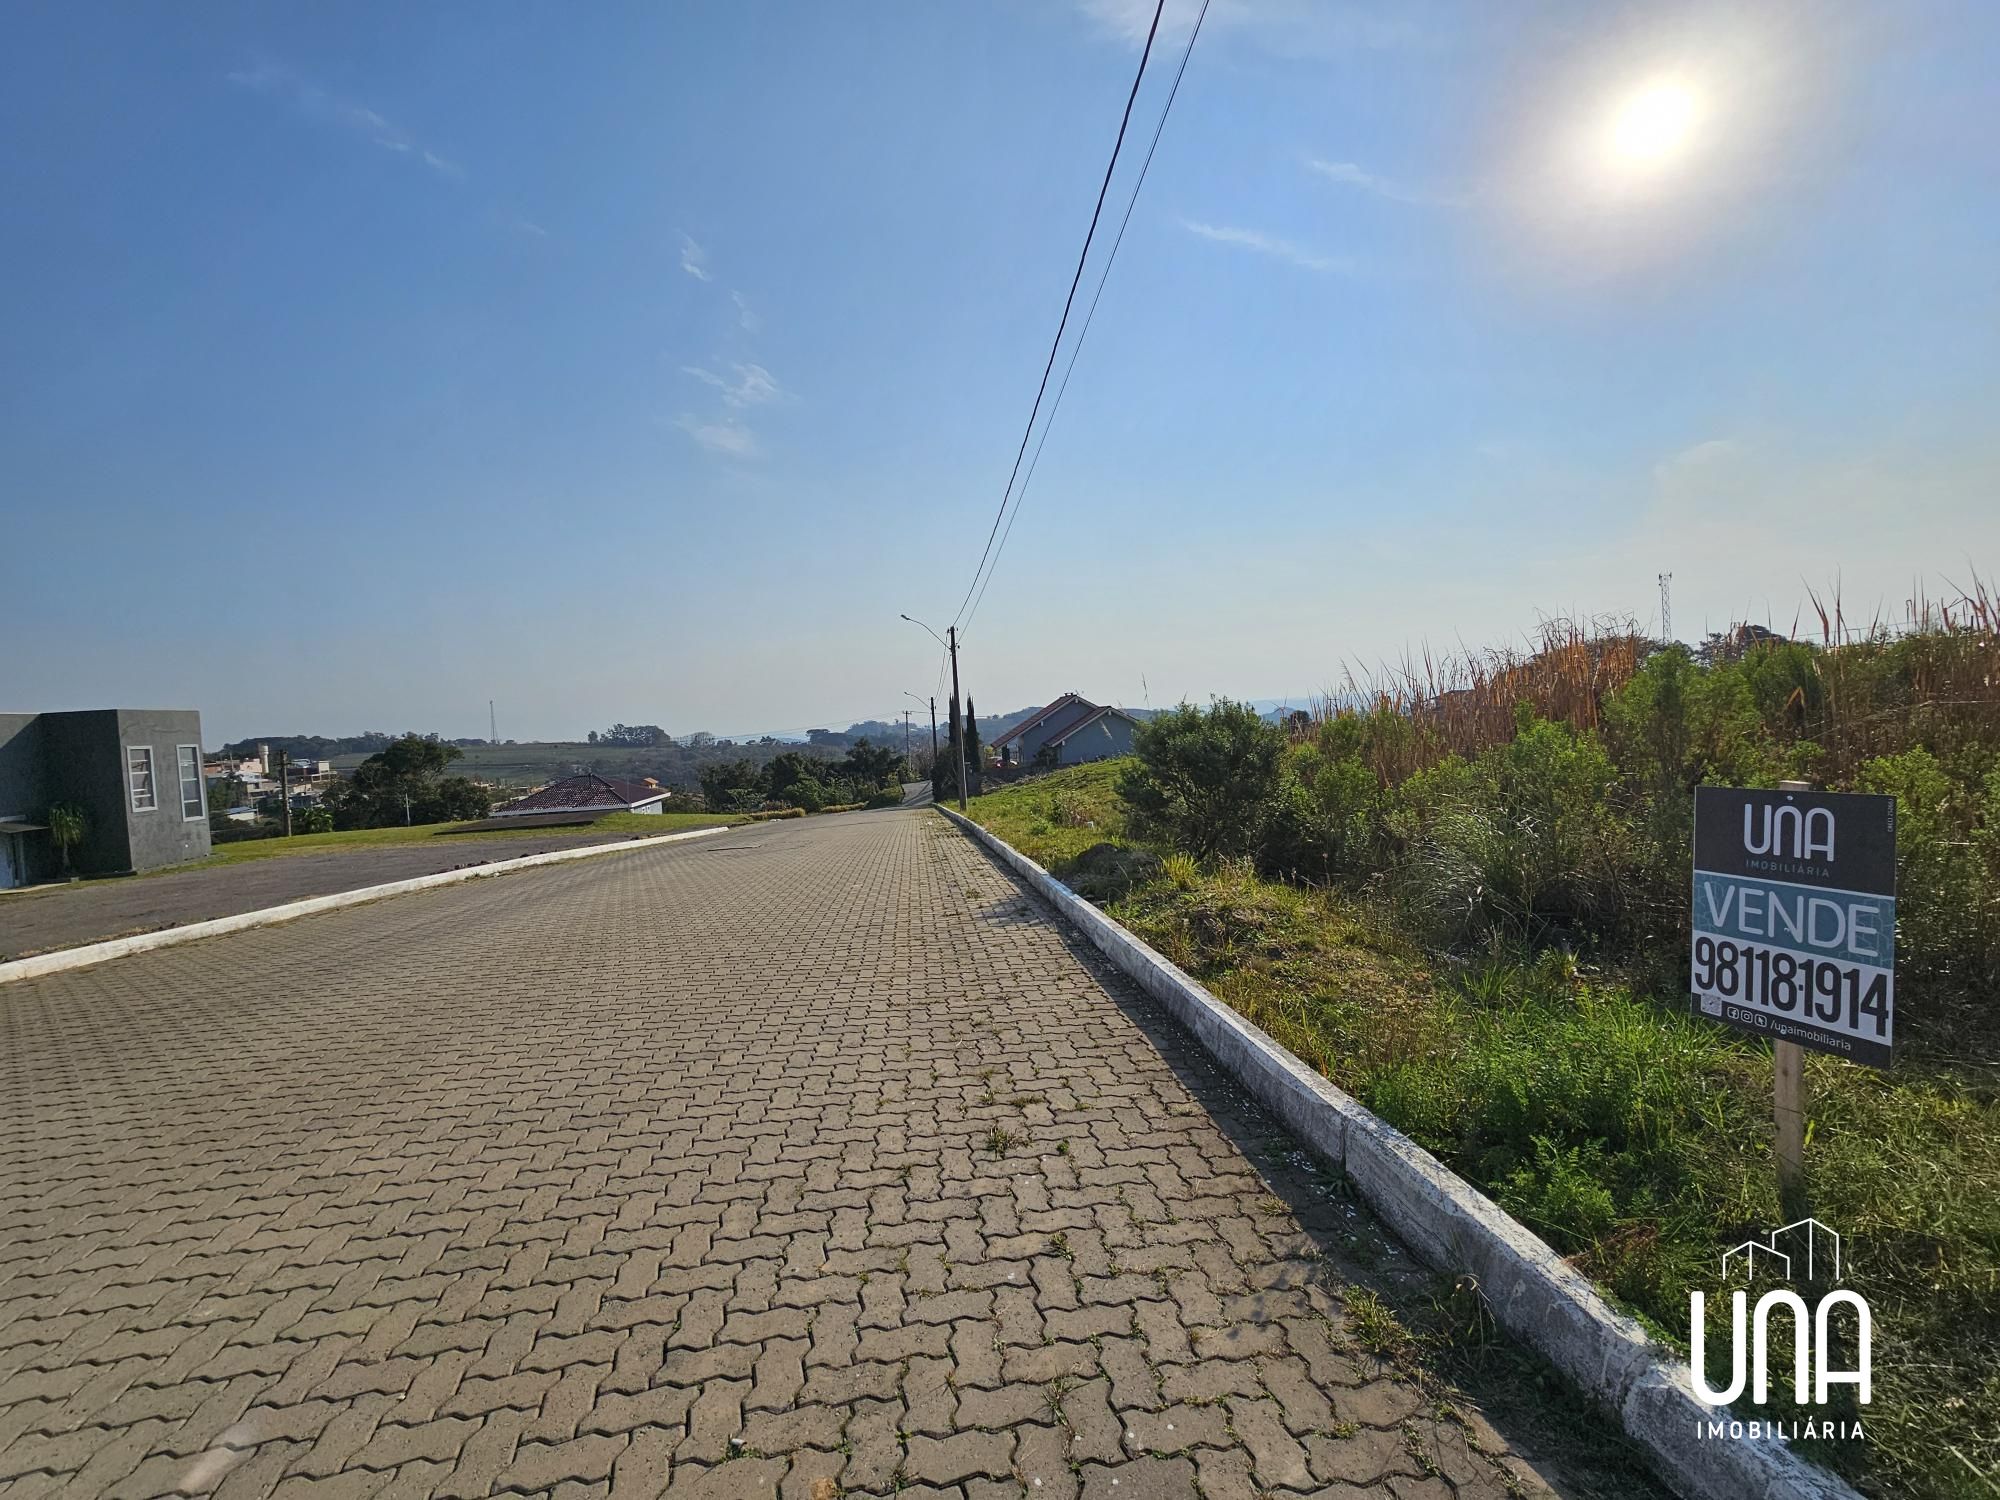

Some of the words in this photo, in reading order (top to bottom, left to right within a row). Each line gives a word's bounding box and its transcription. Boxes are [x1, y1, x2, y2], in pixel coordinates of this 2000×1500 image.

[1744, 804, 1835, 862] UNA
[1746, 859, 1830, 878] IMOBILIÁRIA
[1704, 881, 1880, 958] VENDE
